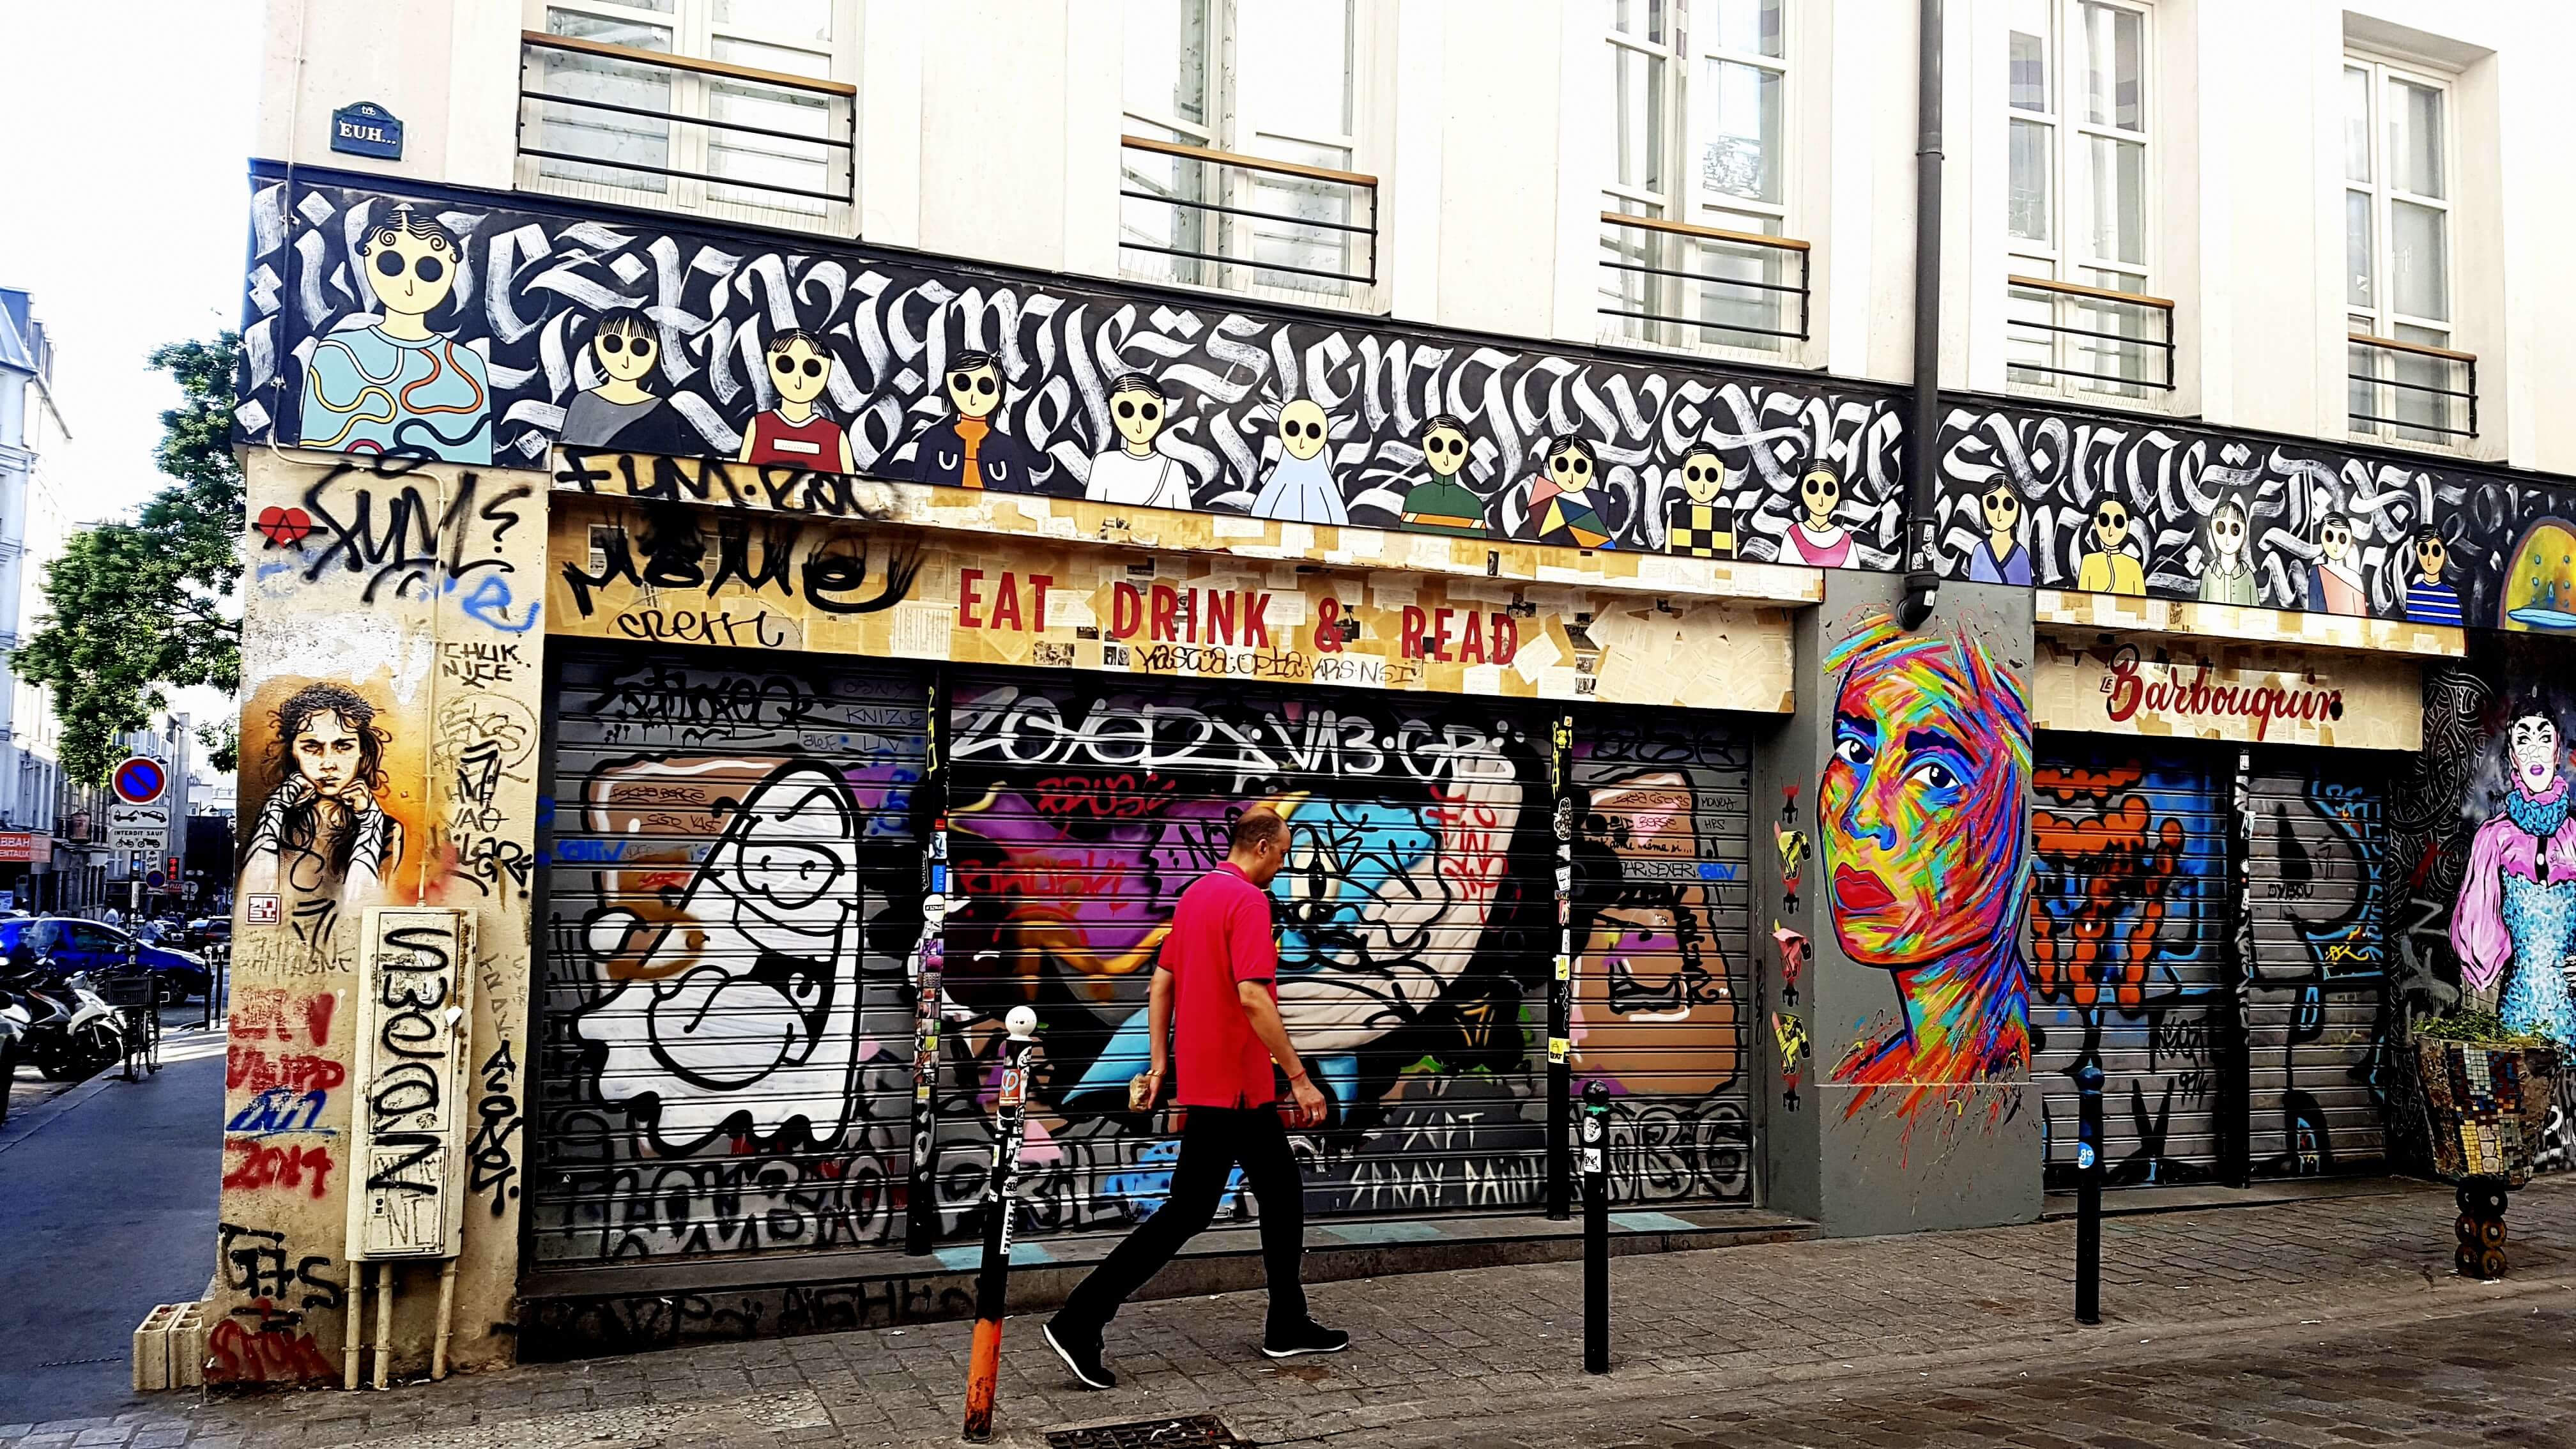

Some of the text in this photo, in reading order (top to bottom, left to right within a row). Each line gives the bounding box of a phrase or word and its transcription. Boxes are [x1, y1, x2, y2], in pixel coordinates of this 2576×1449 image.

[339, 120, 397, 144] EUH...
[959, 568, 1519, 665] EAT DRINK & READ
